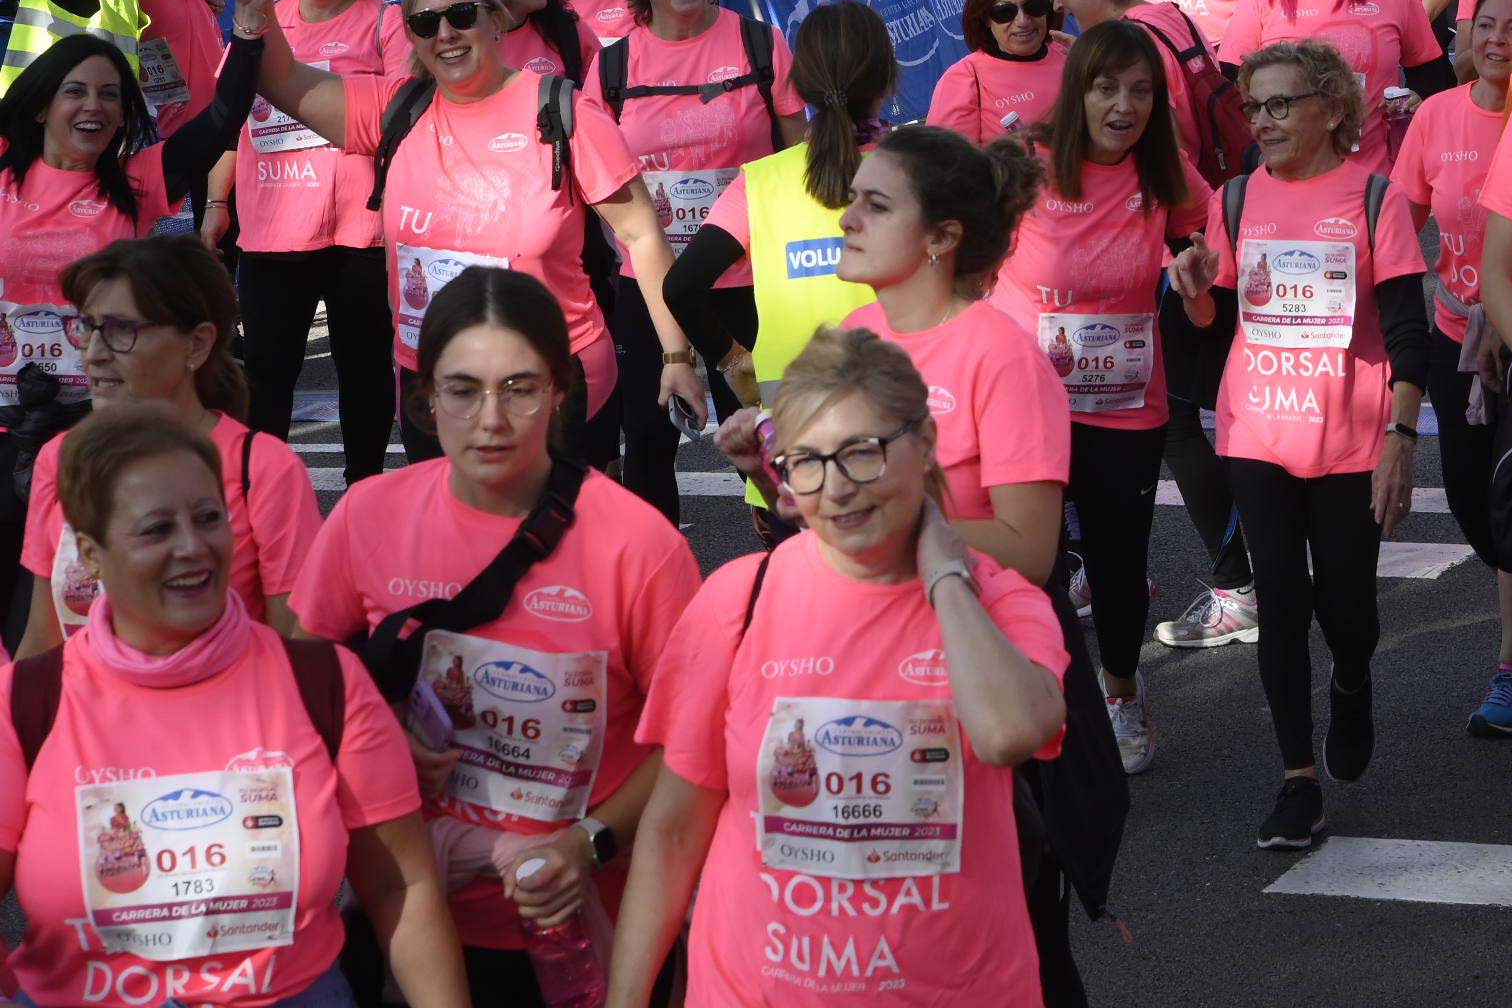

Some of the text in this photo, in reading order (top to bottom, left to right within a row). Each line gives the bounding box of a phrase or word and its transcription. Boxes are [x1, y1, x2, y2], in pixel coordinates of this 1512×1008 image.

[638, 152, 670, 172] TU
[258, 159, 318, 182] SUMA
[673, 185, 712, 195] ASTURIANA
[675, 207, 710, 221] 016
[1046, 199, 1094, 213] OYSHO
[399, 205, 432, 234] TU
[789, 247, 841, 269] VOLU
[1275, 256, 1317, 270] ASTURIANA
[1036, 284, 1073, 307] TU
[1276, 284, 1315, 299] 016
[1282, 304, 1307, 314] 5283
[19, 317, 61, 328] ASTURIAN
[1252, 315, 1281, 324] CARRERA
[1302, 317, 1327, 325] MUJER
[1076, 329, 1117, 342] ASTURIANA
[1252, 328, 1345, 340] OYSHO Santander
[21, 343, 62, 358] 016
[1077, 355, 1115, 370] 016
[1082, 374, 1106, 383] 5276
[532, 596, 588, 616] ASTURIANA
[761, 657, 834, 679] OYSHO
[478, 670, 549, 697] ASTURIANA
[481, 709, 541, 740] 016
[910, 724, 946, 735] SUMA
[822, 732, 896, 749] ASTURIANA
[519, 766, 556, 782] MUJER
[825, 772, 891, 796] 016
[240, 793, 278, 803] SUMA
[150, 805, 227, 823] ASTURIANA
[833, 804, 882, 820] 16666
[784, 822, 940, 838] CARRERA DE LA MUJER 2023
[157, 844, 227, 873] 016
[781, 845, 945, 864] OYSHO Santander
[172, 879, 215, 897] 1783
[113, 897, 277, 922] CARRERA DE LA MUJER 2023
[220, 921, 281, 938] Santander
[765, 921, 900, 977] SUMA
